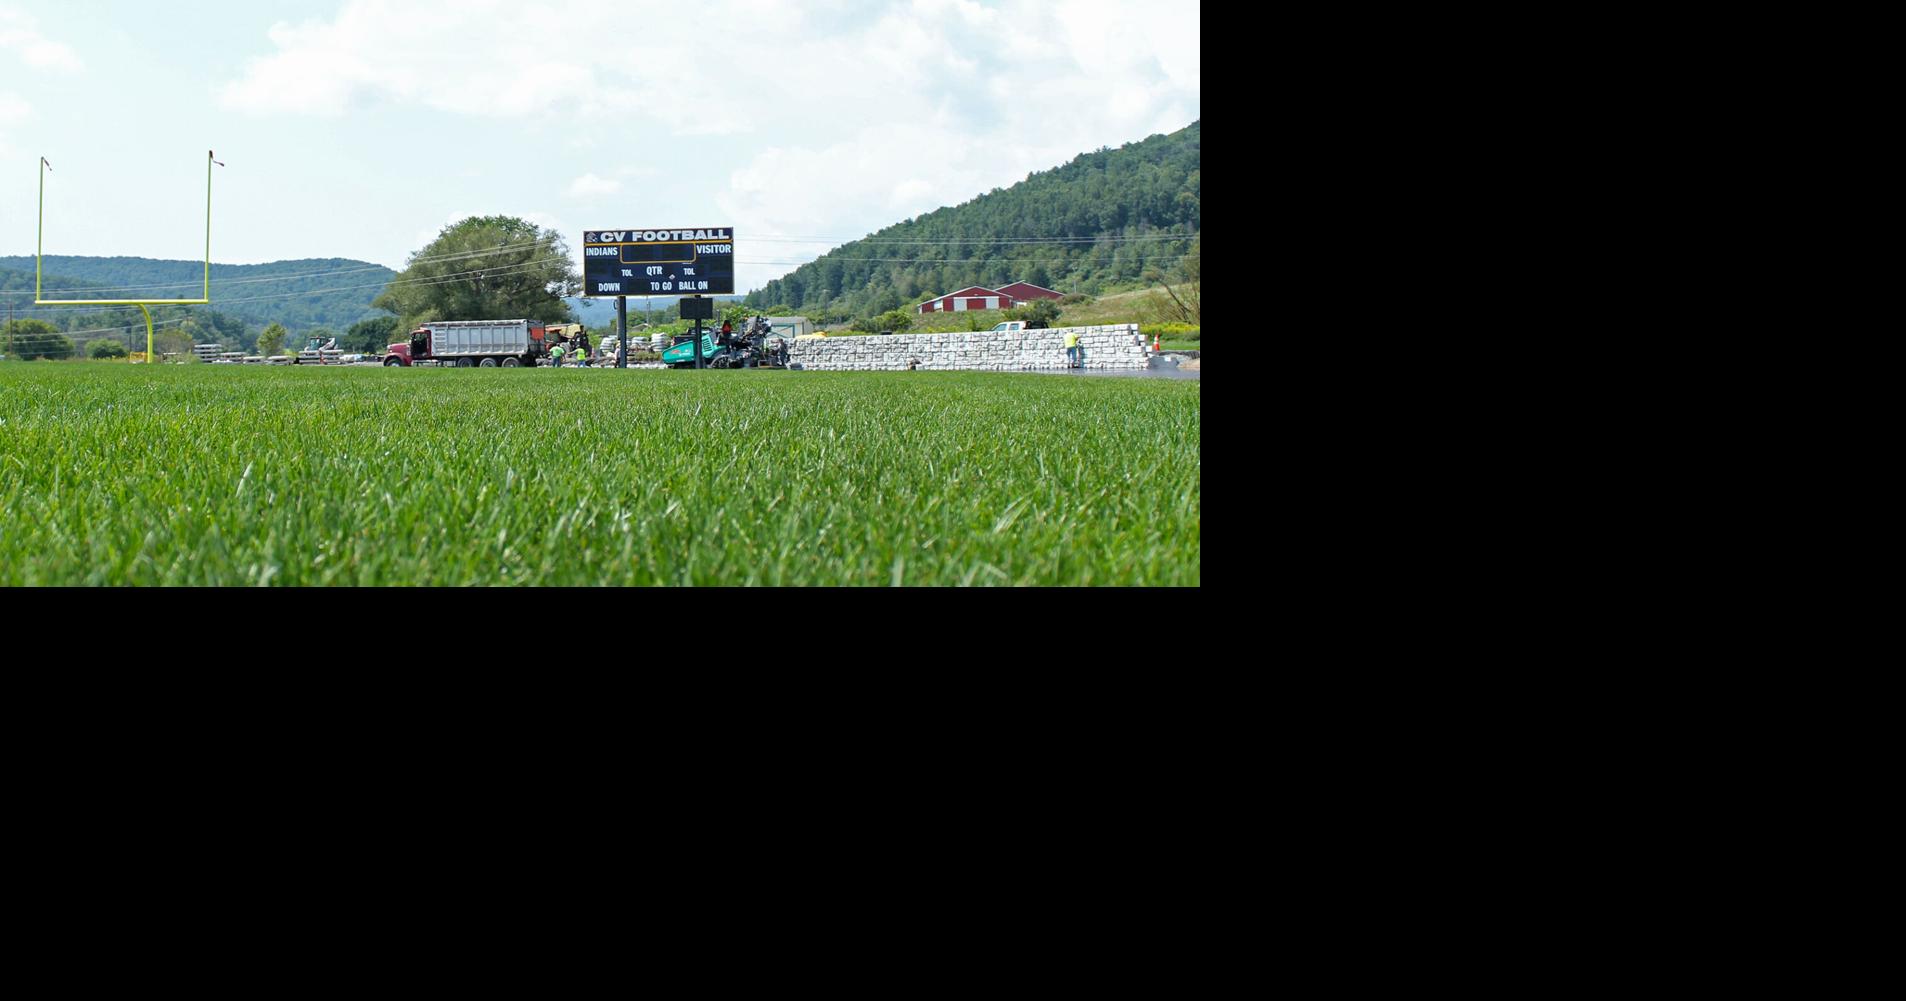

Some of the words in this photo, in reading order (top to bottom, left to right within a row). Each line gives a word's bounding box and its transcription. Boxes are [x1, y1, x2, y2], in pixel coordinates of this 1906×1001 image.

[600, 232, 625, 242] CV
[632, 229, 729, 241] FOOTBALL
[586, 246, 618, 256] INDIANS
[696, 244, 732, 254] VISITOR
[621, 269, 633, 277] TOL
[646, 266, 663, 275] QTR
[683, 268, 695, 276] TOL
[598, 282, 620, 292] DOWN
[650, 281, 659, 291] TO
[662, 281, 672, 291] GO
[678, 281, 696, 290] BALL
[698, 280, 708, 290] ON
